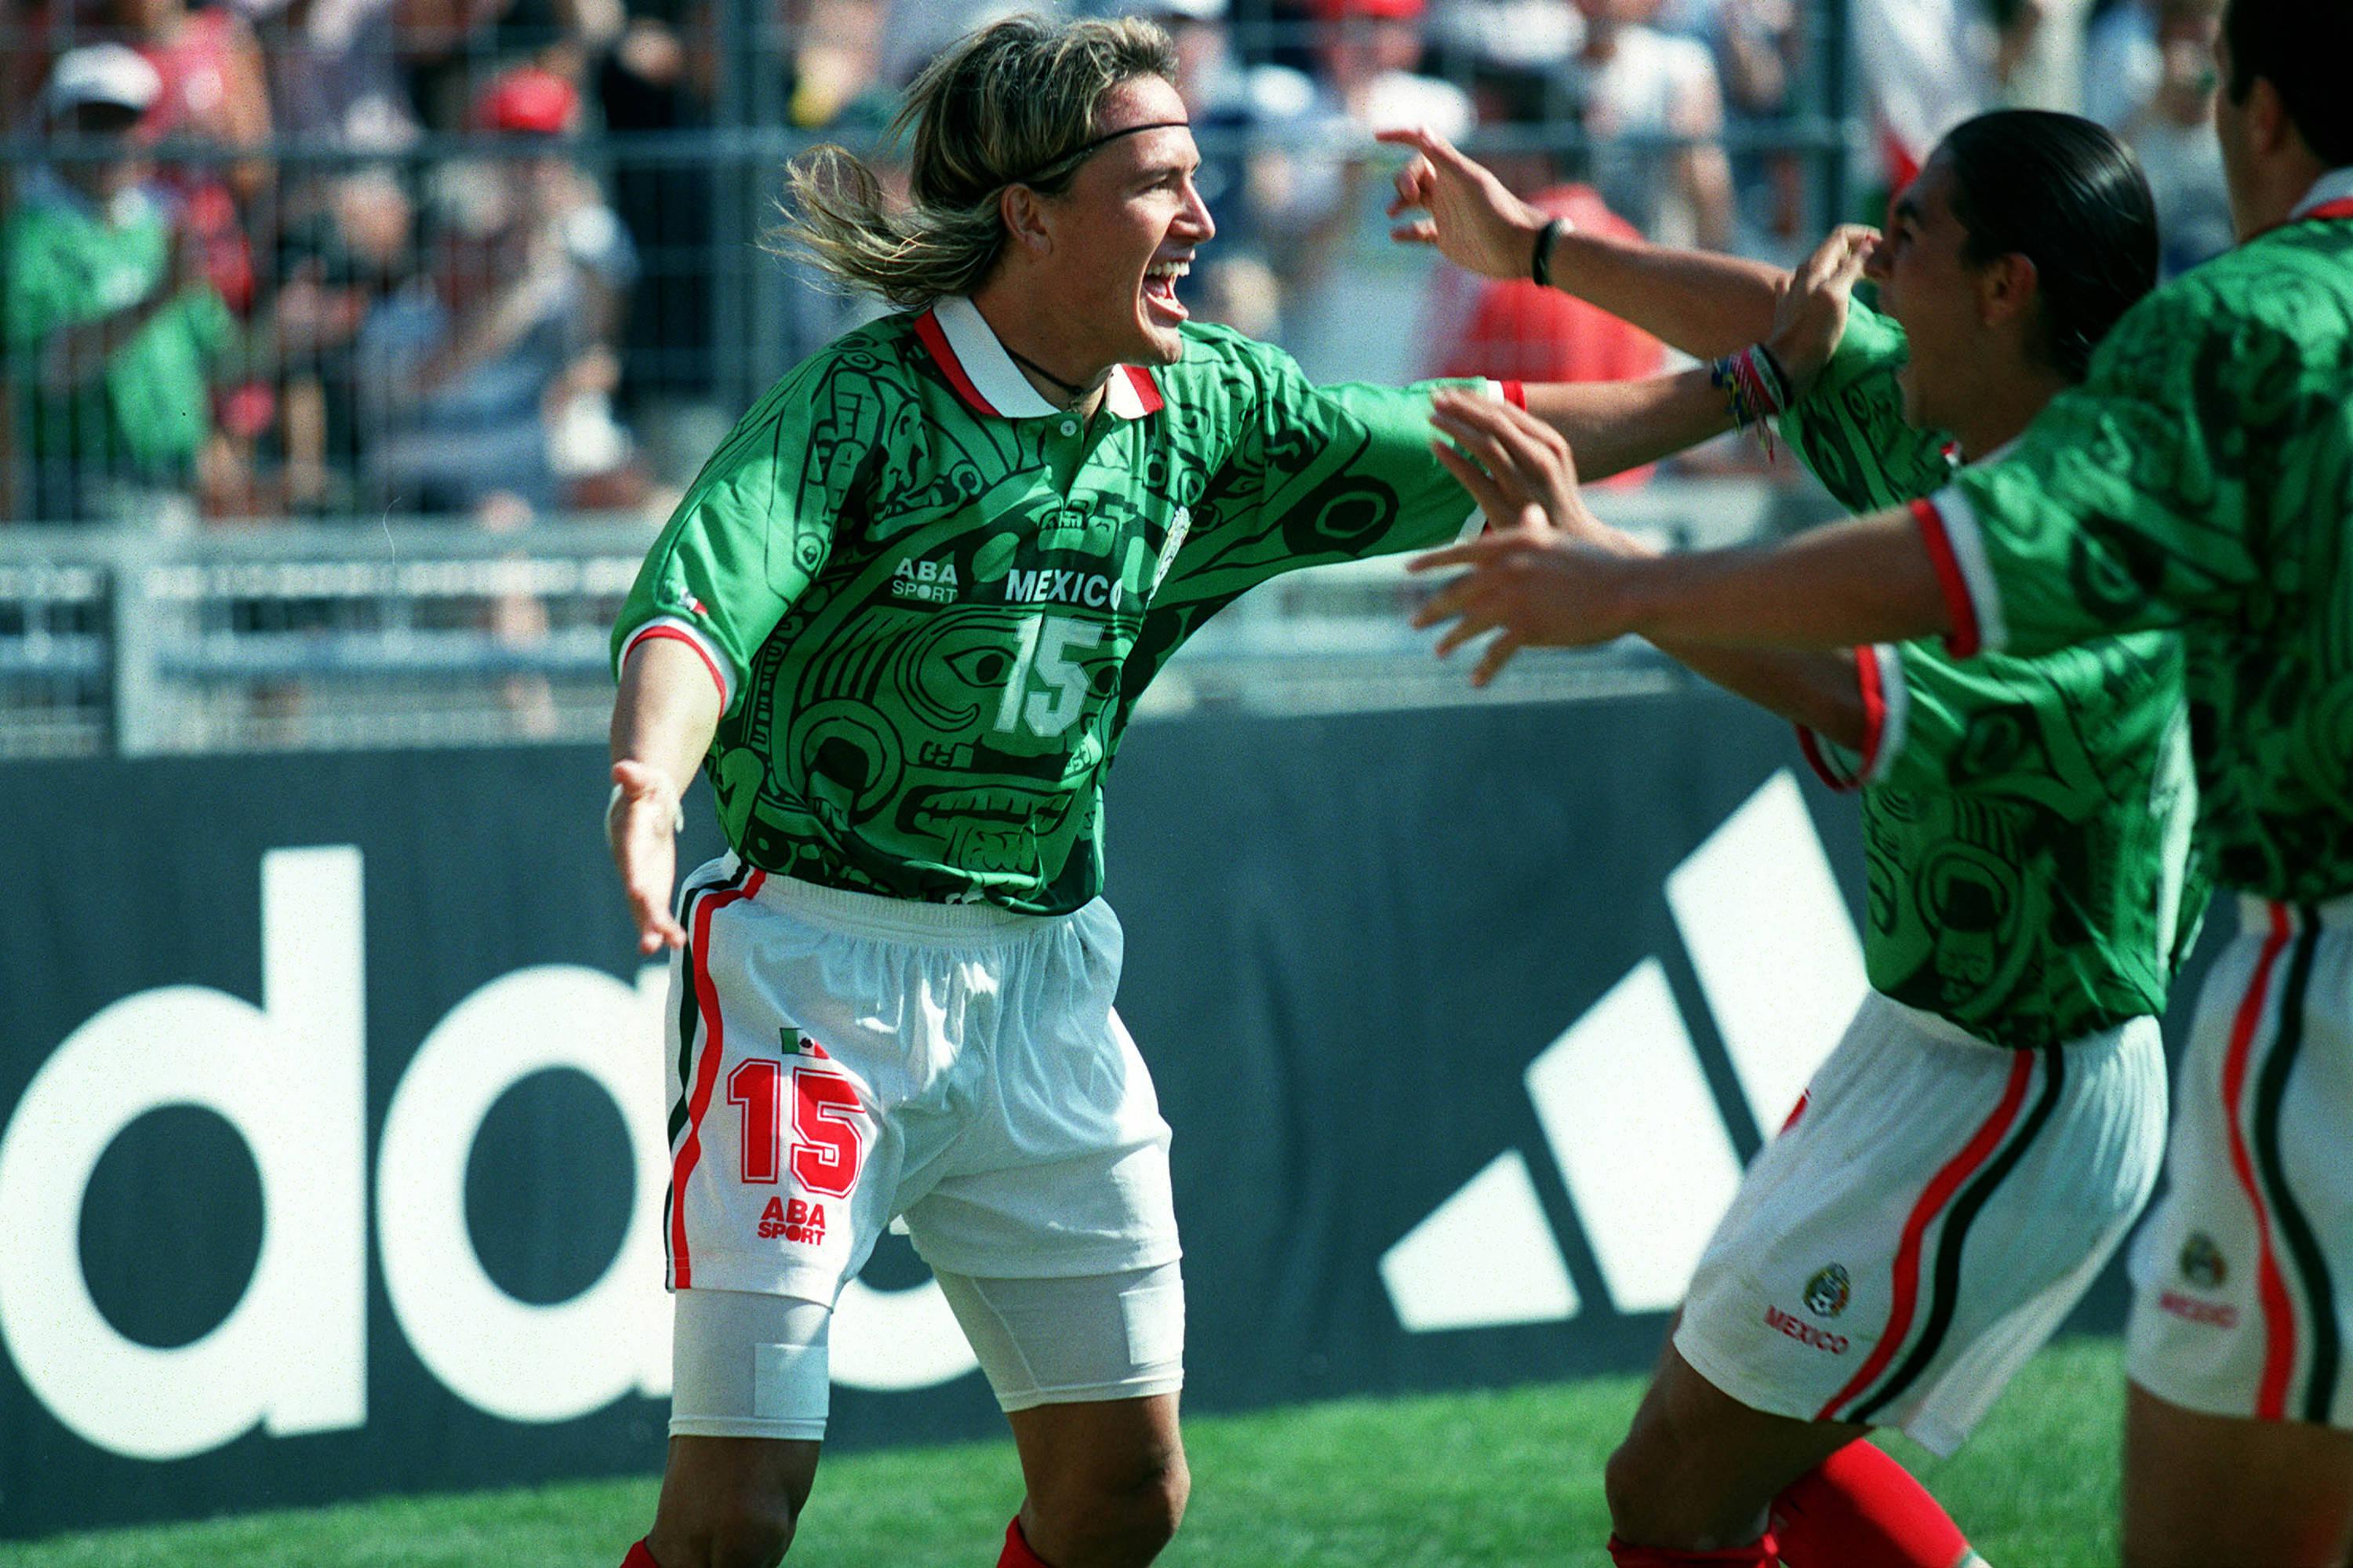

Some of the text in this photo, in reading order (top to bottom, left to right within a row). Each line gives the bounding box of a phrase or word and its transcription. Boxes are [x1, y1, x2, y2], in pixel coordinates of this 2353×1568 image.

[894, 558, 959, 586] ABA
[891, 580, 958, 604] SPORT
[993, 615, 1105, 737] 15
[727, 1057, 865, 1199] 15
[761, 1196, 826, 1229] ABA
[757, 1221, 826, 1246] SPORT
[1764, 1304, 1849, 1355] MEXICO
